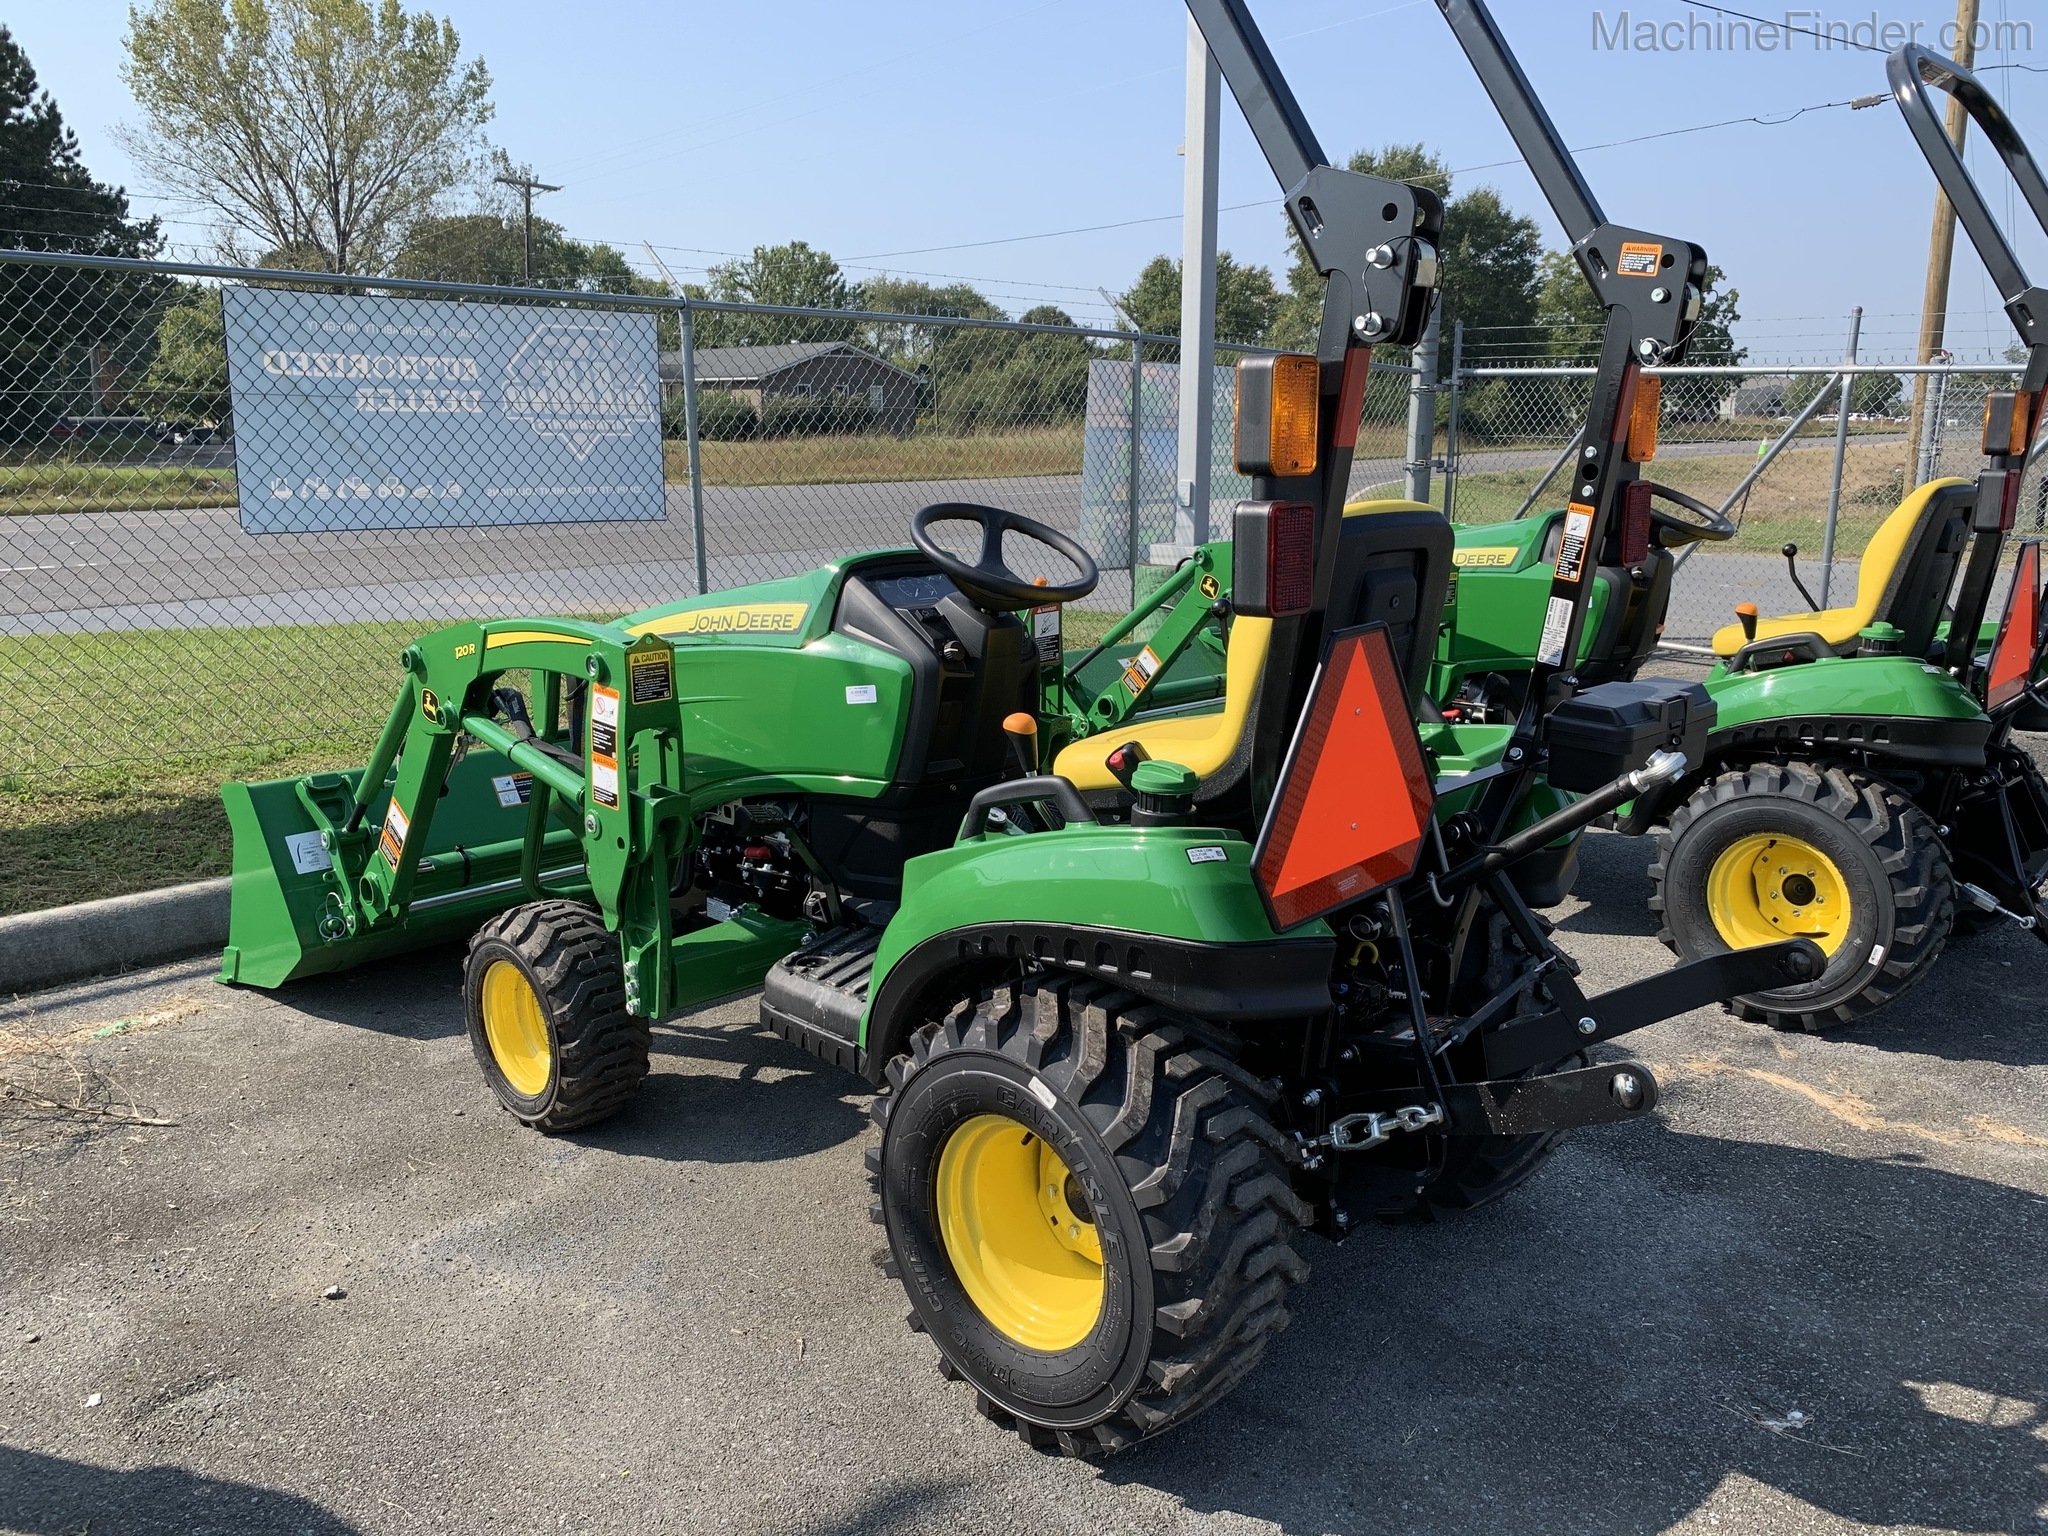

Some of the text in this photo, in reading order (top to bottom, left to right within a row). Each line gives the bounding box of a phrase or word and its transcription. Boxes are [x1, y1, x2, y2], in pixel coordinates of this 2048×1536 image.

[1455, 552, 1507, 565] DEERE
[688, 610, 795, 631] JOHN DEERE
[641, 651, 668, 663] CAUTION
[996, 1085, 1123, 1260] CARLISLE
